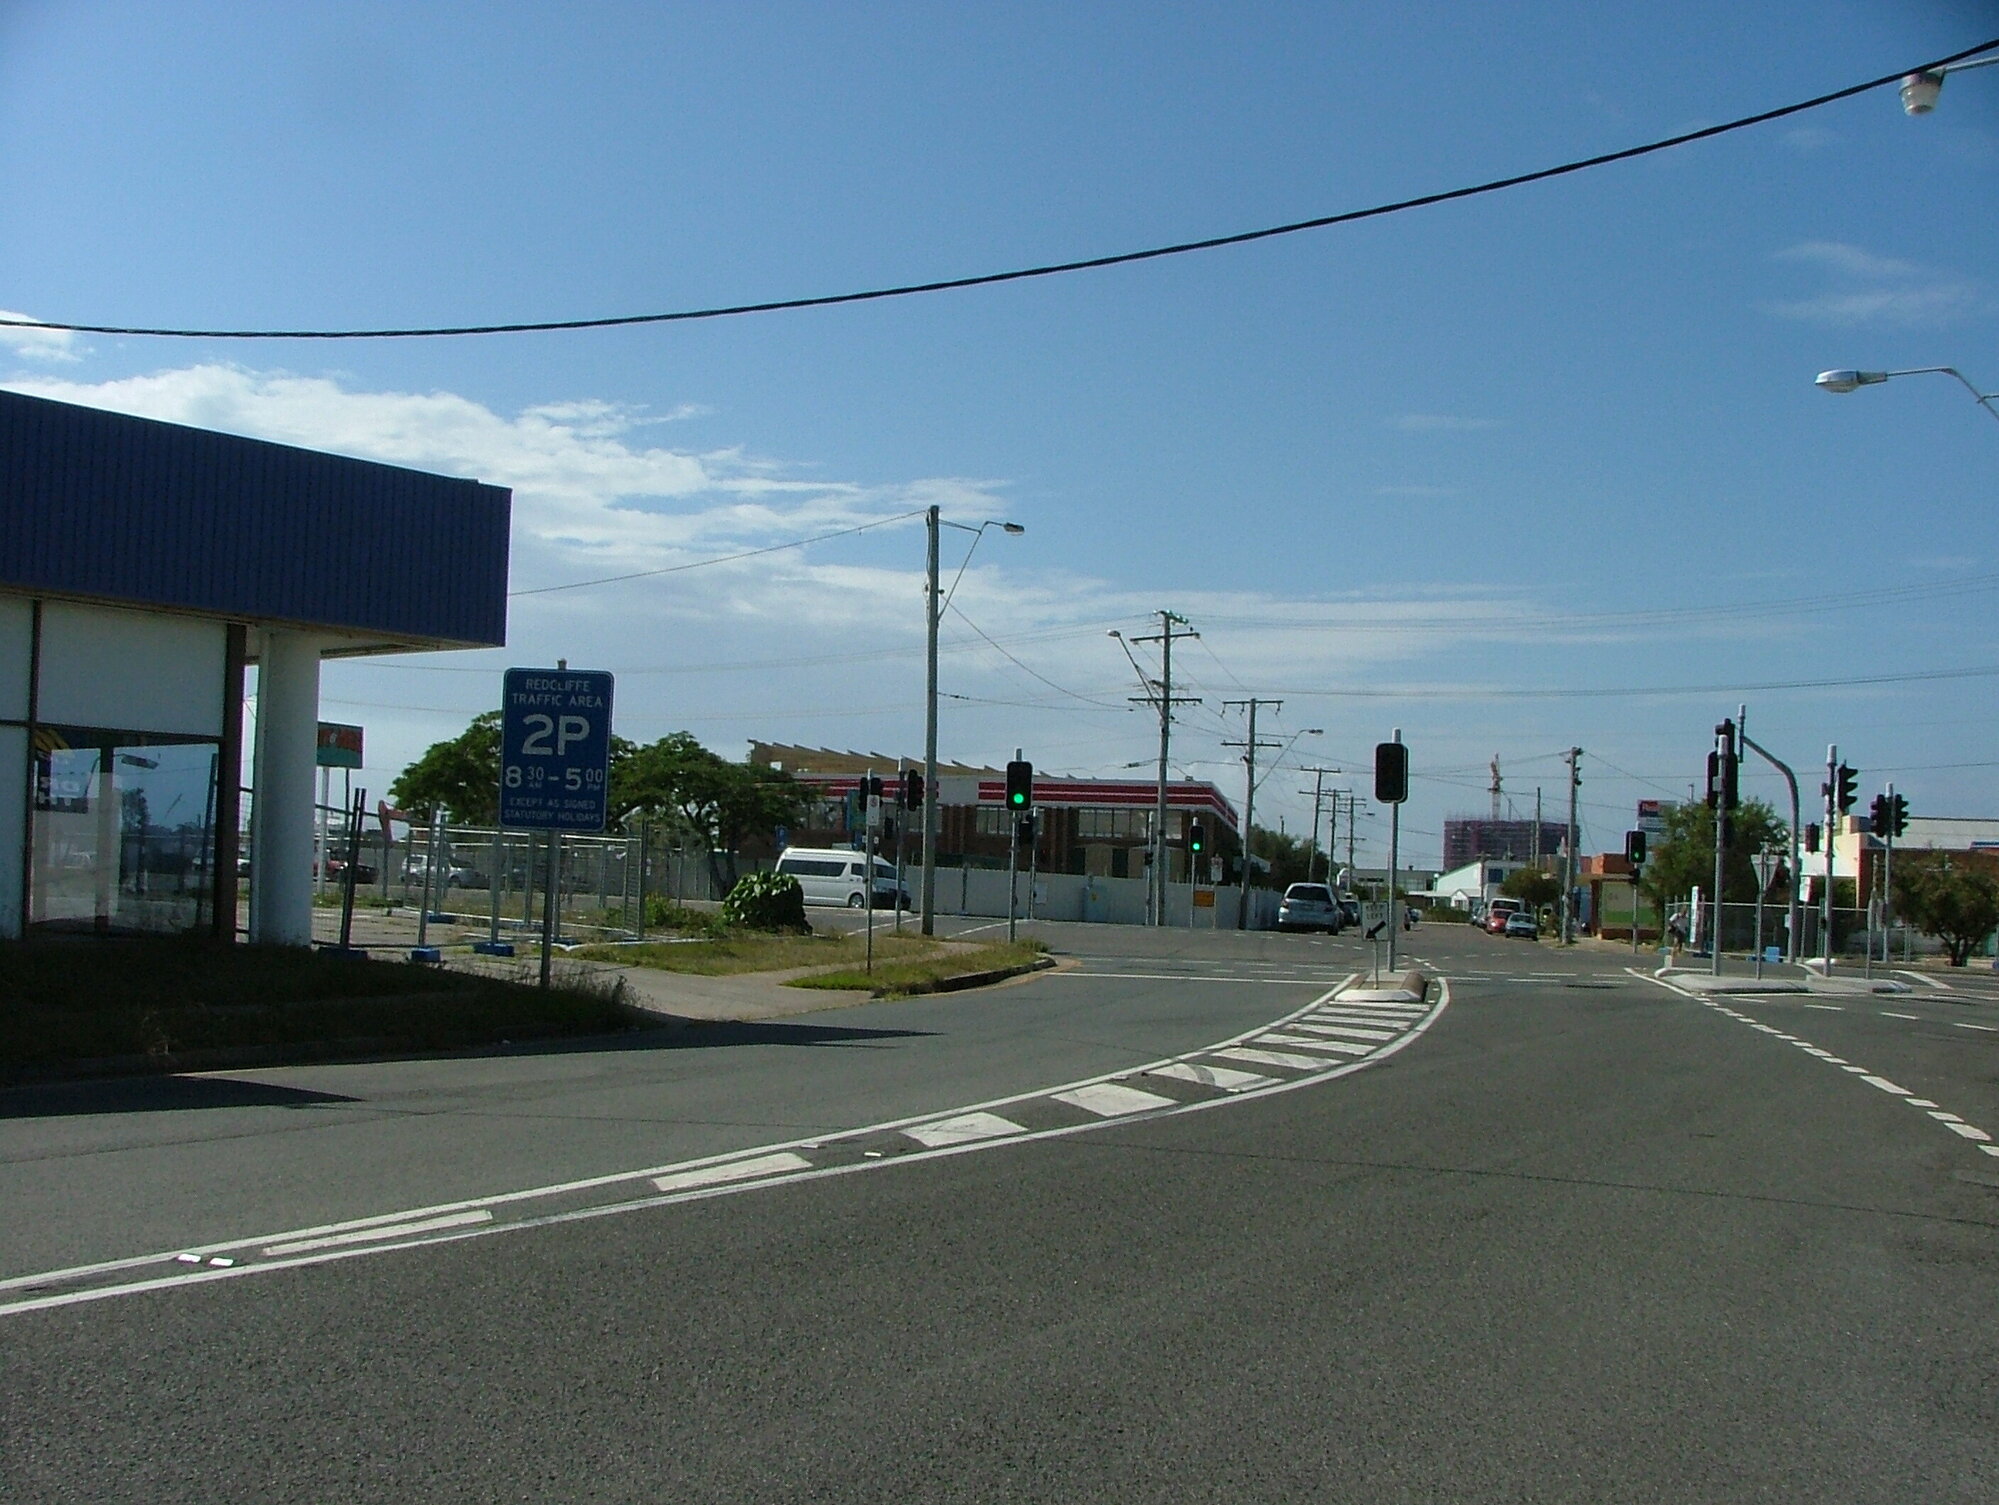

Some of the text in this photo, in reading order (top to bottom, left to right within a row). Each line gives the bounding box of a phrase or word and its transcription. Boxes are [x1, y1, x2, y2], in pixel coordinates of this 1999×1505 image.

[526, 678, 590, 691] REDCLIFFE
[513, 693, 603, 708] TRAFFIC AREA
[522, 713, 590, 756] 2P
[505, 766, 521, 788] 8
[527, 766, 544, 780] 30
[565, 768, 581, 790] 5
[586, 768, 603, 782] 00
[587, 783, 600, 791] PM
[510, 797, 596, 810] EXCEPT AS SIGNED
[558, 812, 600, 822] HOLIDAYS
